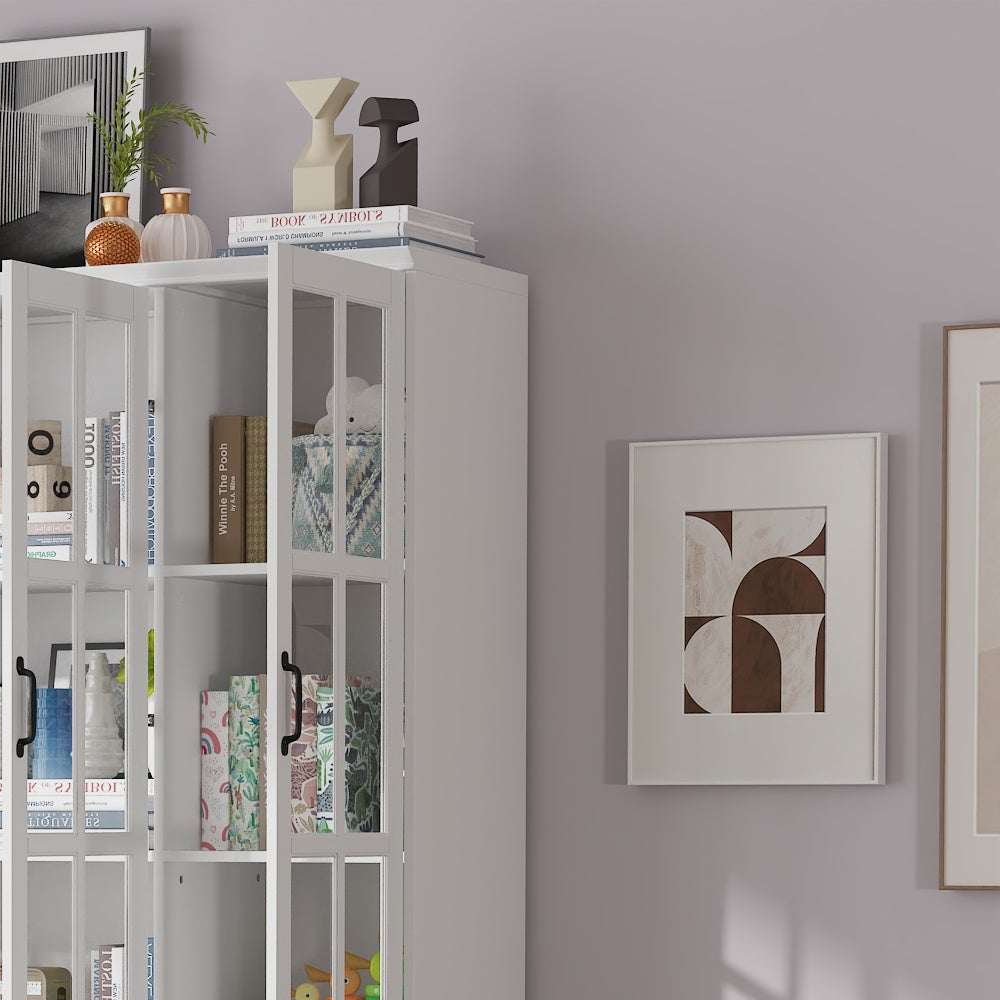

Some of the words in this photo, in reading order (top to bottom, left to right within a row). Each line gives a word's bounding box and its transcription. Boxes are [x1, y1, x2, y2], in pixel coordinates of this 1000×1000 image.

[219, 443, 228, 472] Pooh
[219, 474, 228, 495] The
[219, 498, 228, 536] Winnie
[230, 503, 236, 512] by
